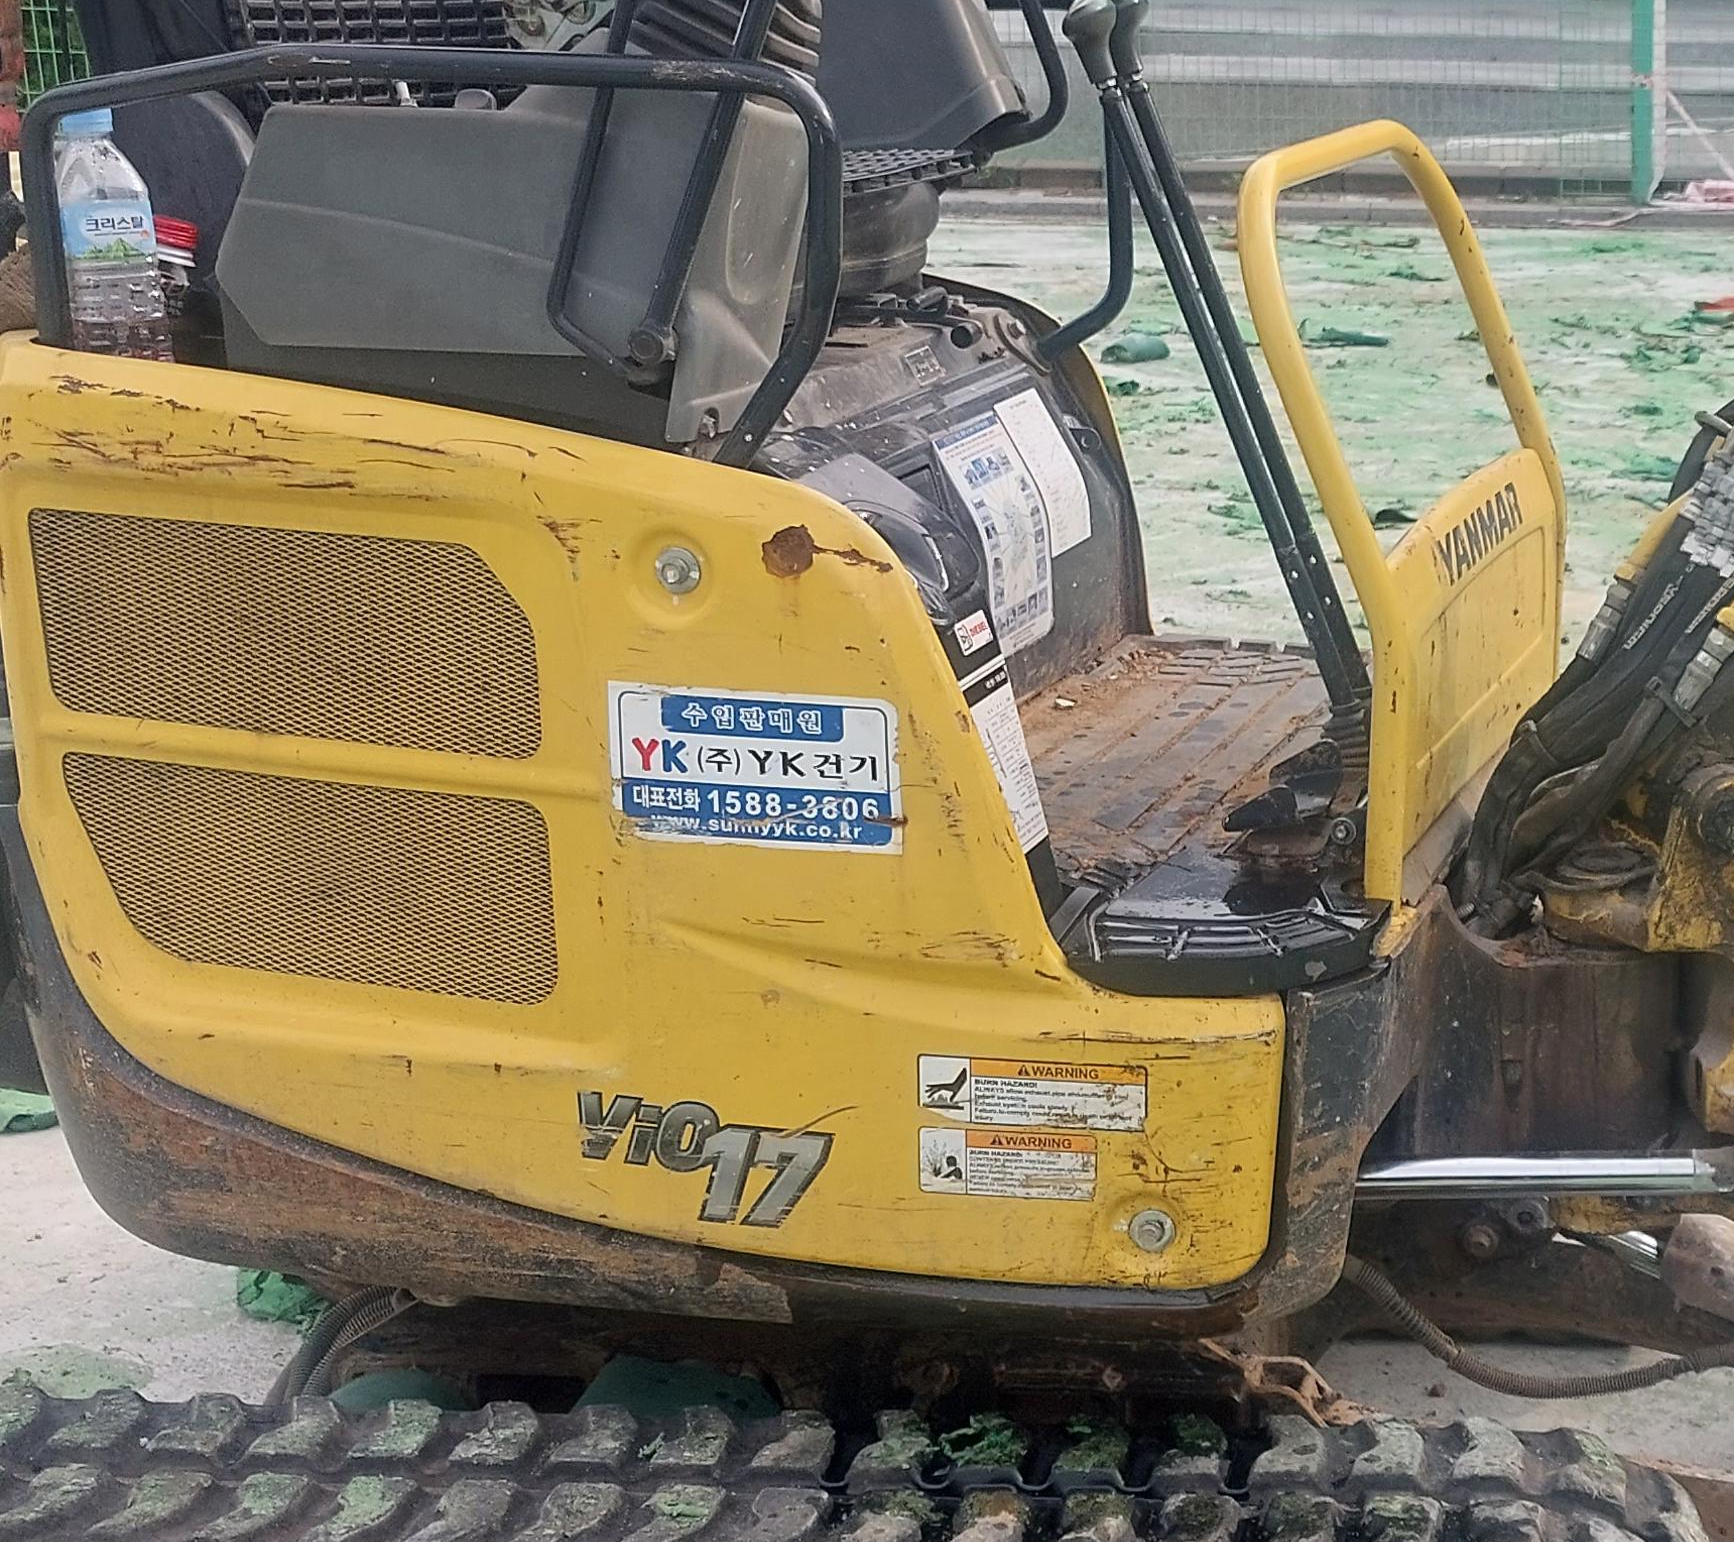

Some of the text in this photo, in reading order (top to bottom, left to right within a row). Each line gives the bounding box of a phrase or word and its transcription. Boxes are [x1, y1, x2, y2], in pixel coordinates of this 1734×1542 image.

[86, 216, 144, 232] 크리스탈
[1435, 482, 1524, 587] YANMAR
[681, 702, 822, 735] 수입판매원
[631, 736, 689, 774] YK
[633, 785, 879, 820] 대표전화 1588-3806
[1031, 1065, 1100, 1080] WARNING
[1005, 1136, 1072, 1149] WARNING
